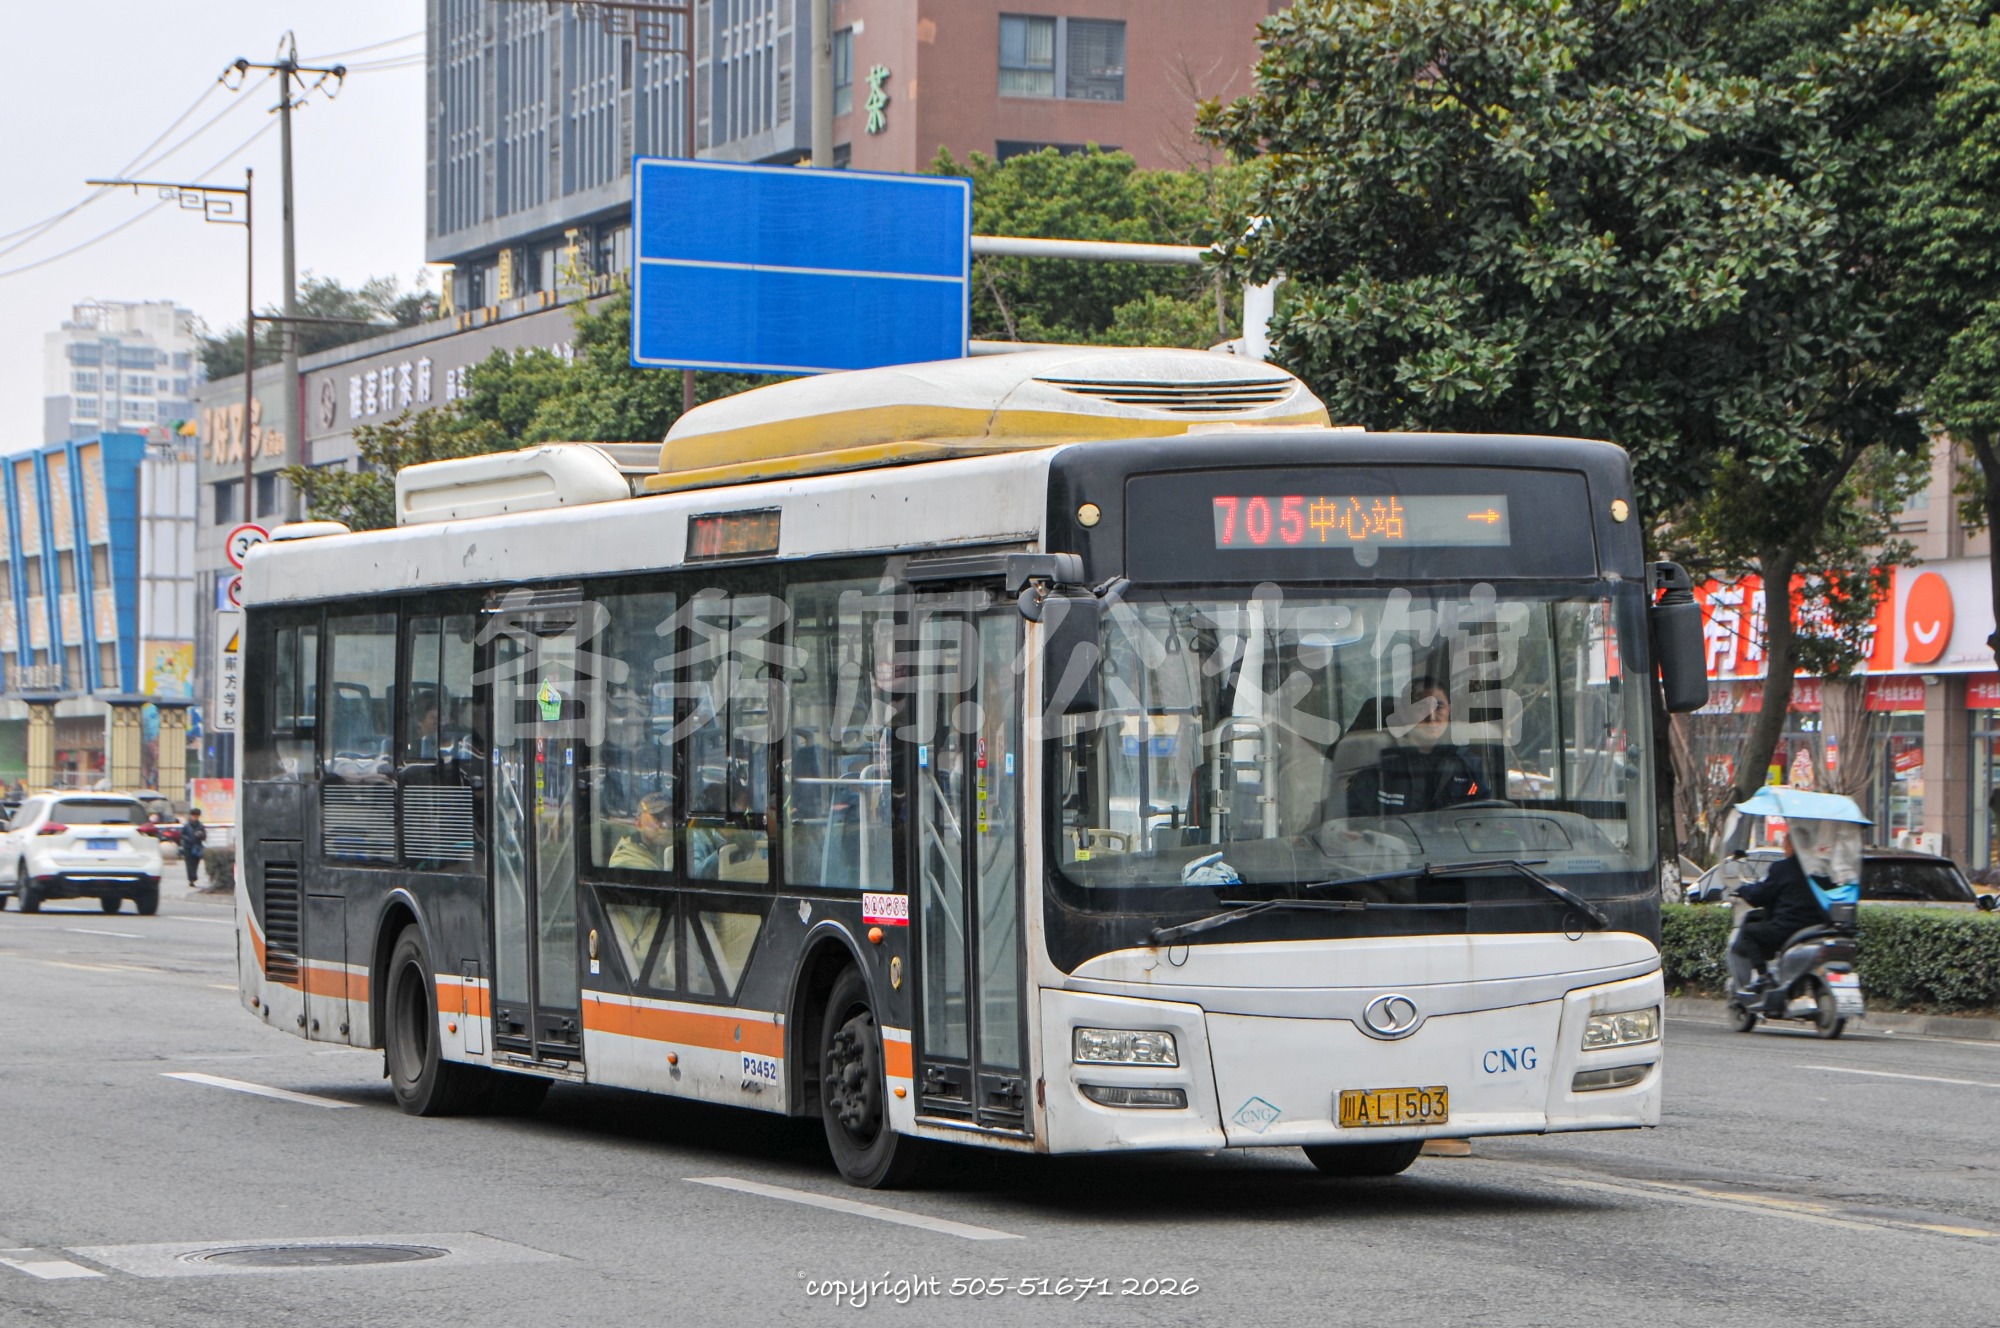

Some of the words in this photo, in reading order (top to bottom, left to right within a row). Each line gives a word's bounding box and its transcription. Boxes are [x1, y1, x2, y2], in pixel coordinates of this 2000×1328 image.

[1215, 497, 1304, 543] 705
[1309, 496, 1403, 542] 中心站
[743, 1057, 776, 1081] P3452
[1483, 1046, 1537, 1074] CNG
[1241, 1107, 1272, 1124] CNG
